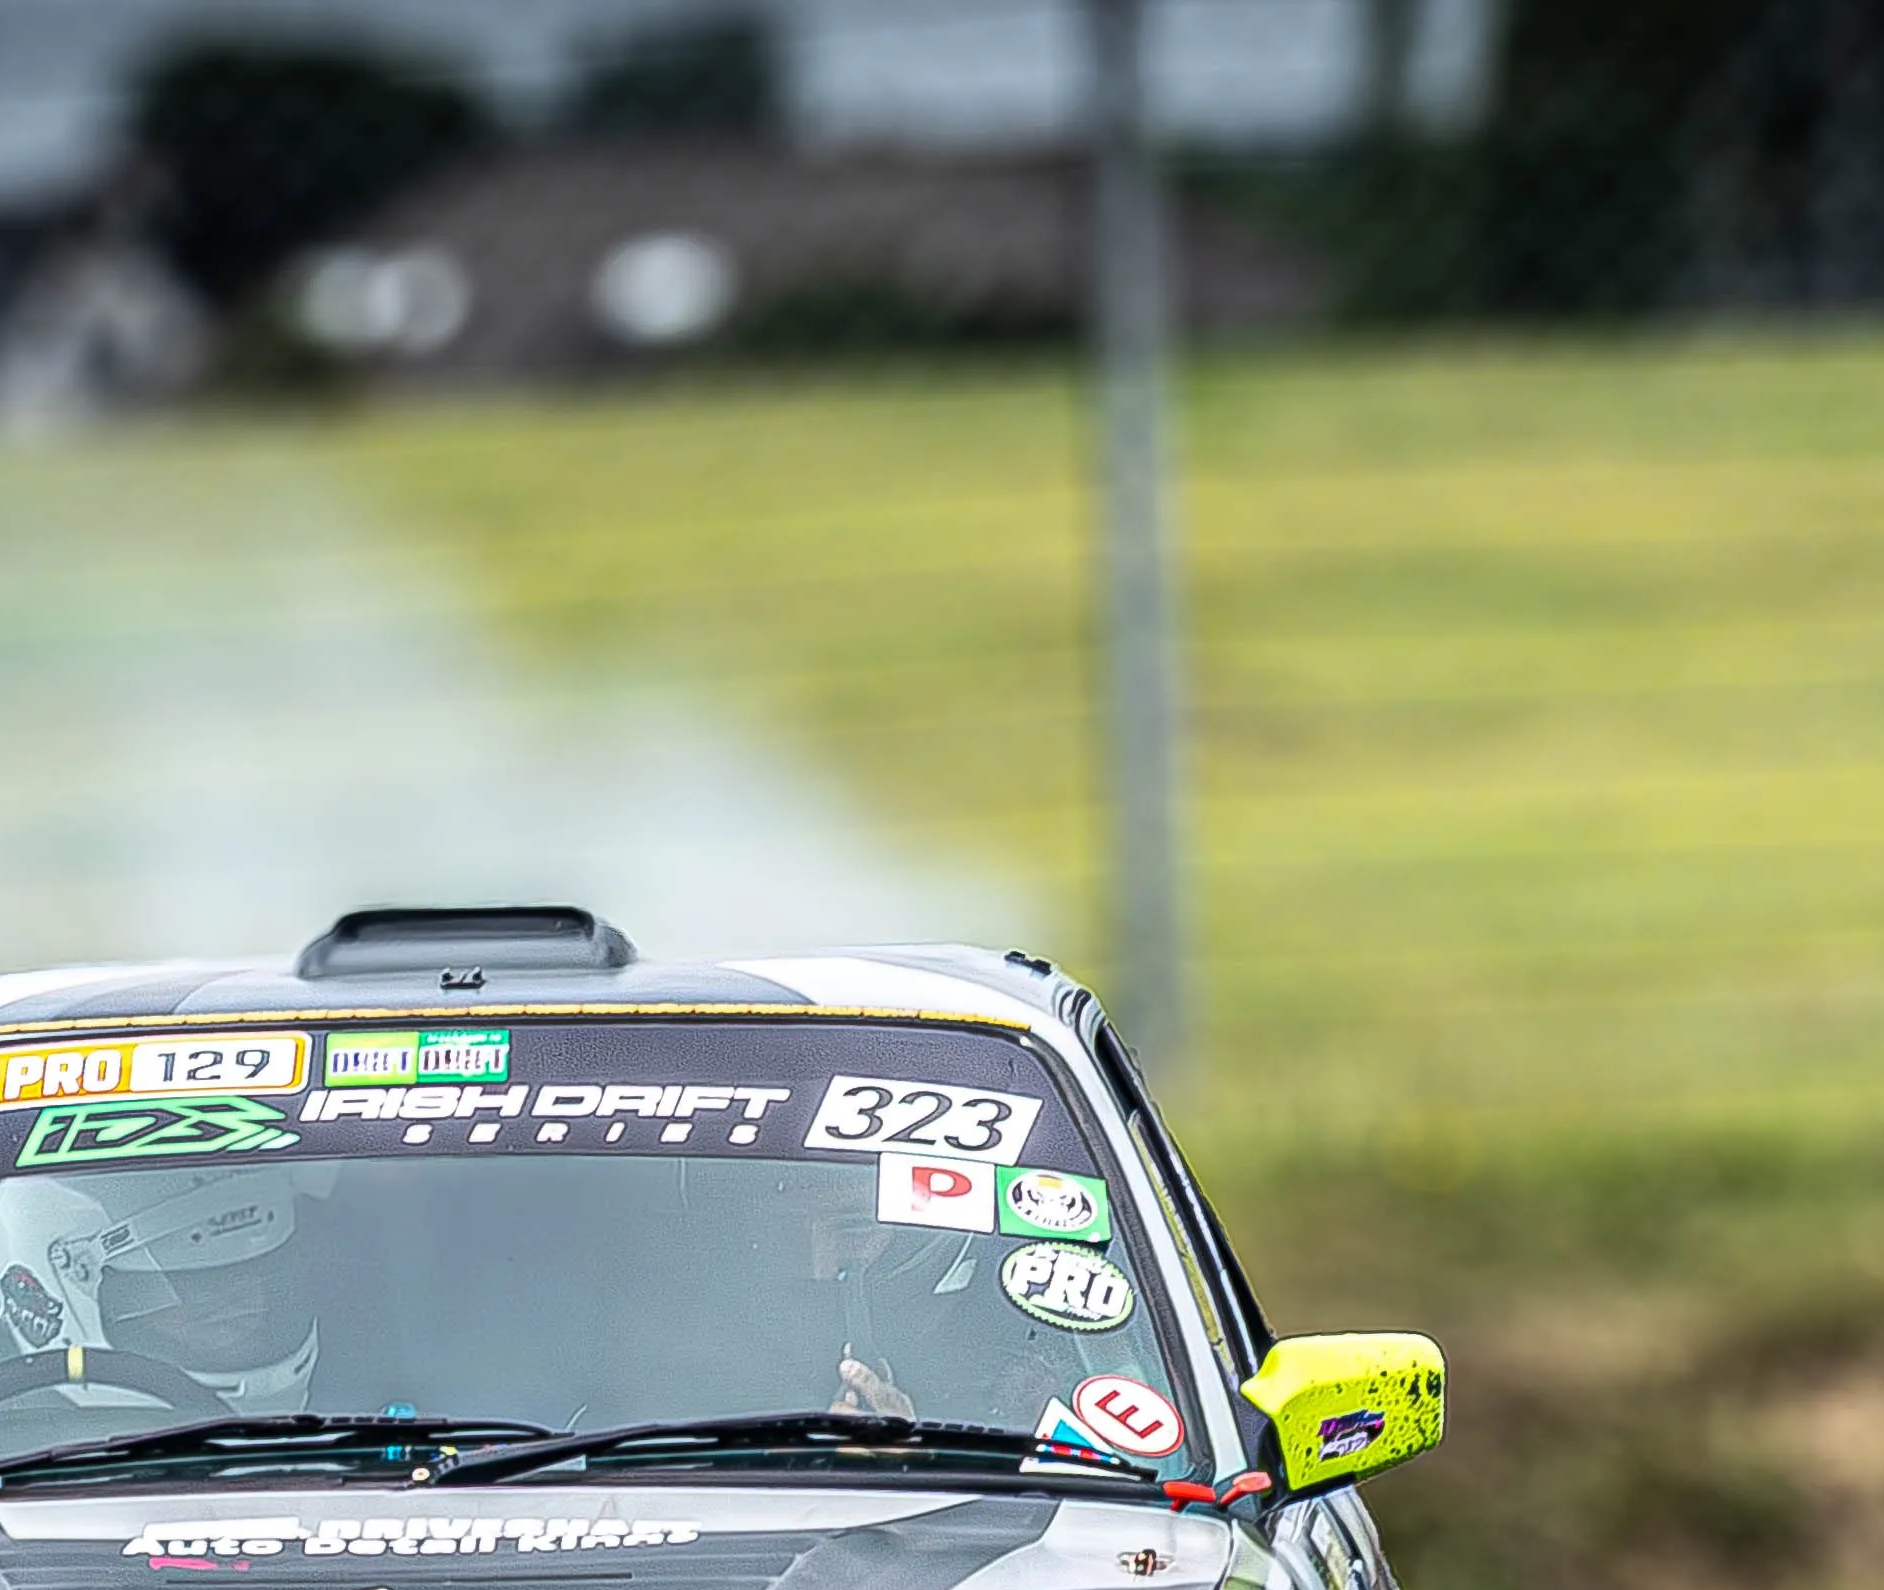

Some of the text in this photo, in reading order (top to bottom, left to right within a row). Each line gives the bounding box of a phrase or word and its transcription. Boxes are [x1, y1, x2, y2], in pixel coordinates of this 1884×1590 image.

[3, 1049, 121, 1099] PRO
[158, 1050, 272, 1081] 129
[300, 1084, 791, 1122] IRISH DRIFT
[823, 1084, 1013, 1152] 323
[401, 1121, 760, 1145] SERIES
[1007, 1252, 1130, 1317] PRO
